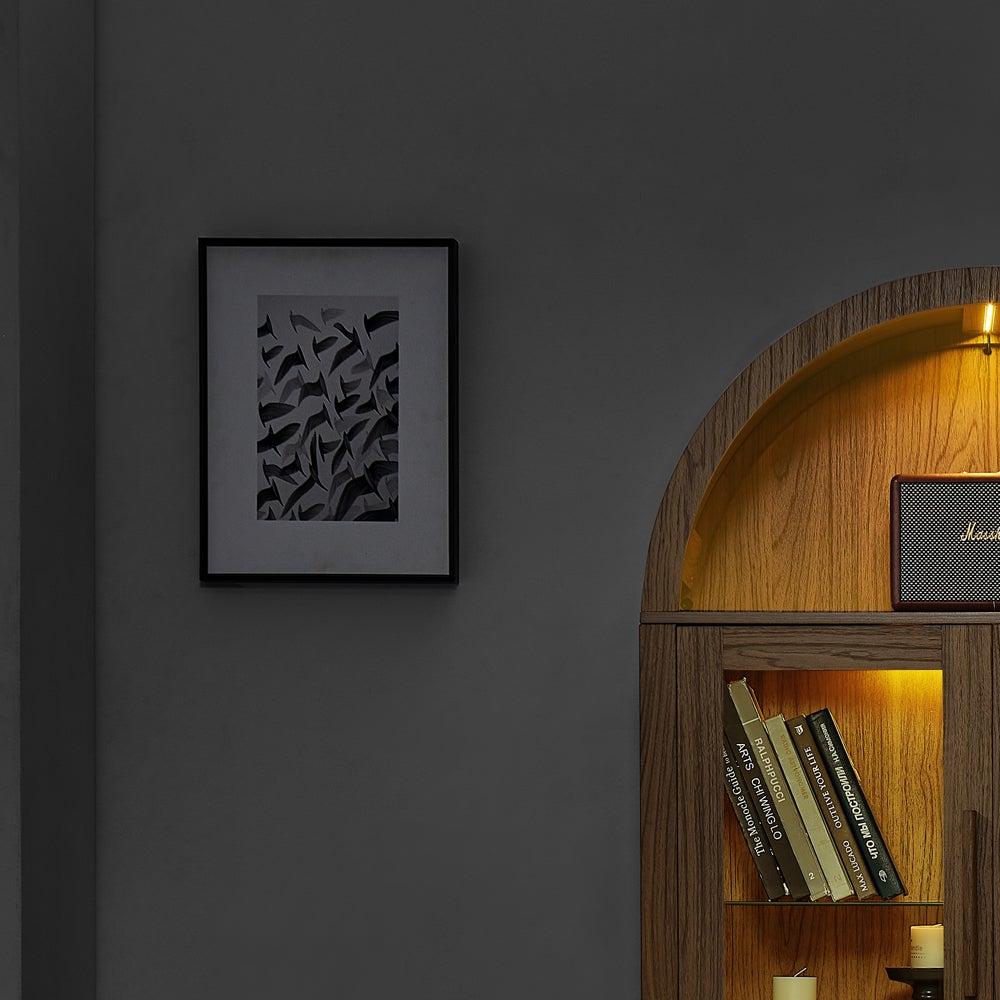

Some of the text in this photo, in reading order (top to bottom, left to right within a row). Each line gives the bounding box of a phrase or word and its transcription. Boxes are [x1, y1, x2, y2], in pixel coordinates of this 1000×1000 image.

[727, 766, 741, 795] Guide
[736, 743, 782, 840] ARTS CHI WING LO
[835, 766, 864, 823] ПОСТРОИЛИ
[737, 795, 758, 837] Monocle
[803, 747, 868, 892] MAX LUCADO OUTLIVE YOUR LIFE
[856, 822, 871, 842] МЫ
[753, 836, 765, 856] The
[865, 840, 879, 860] ЧТО
